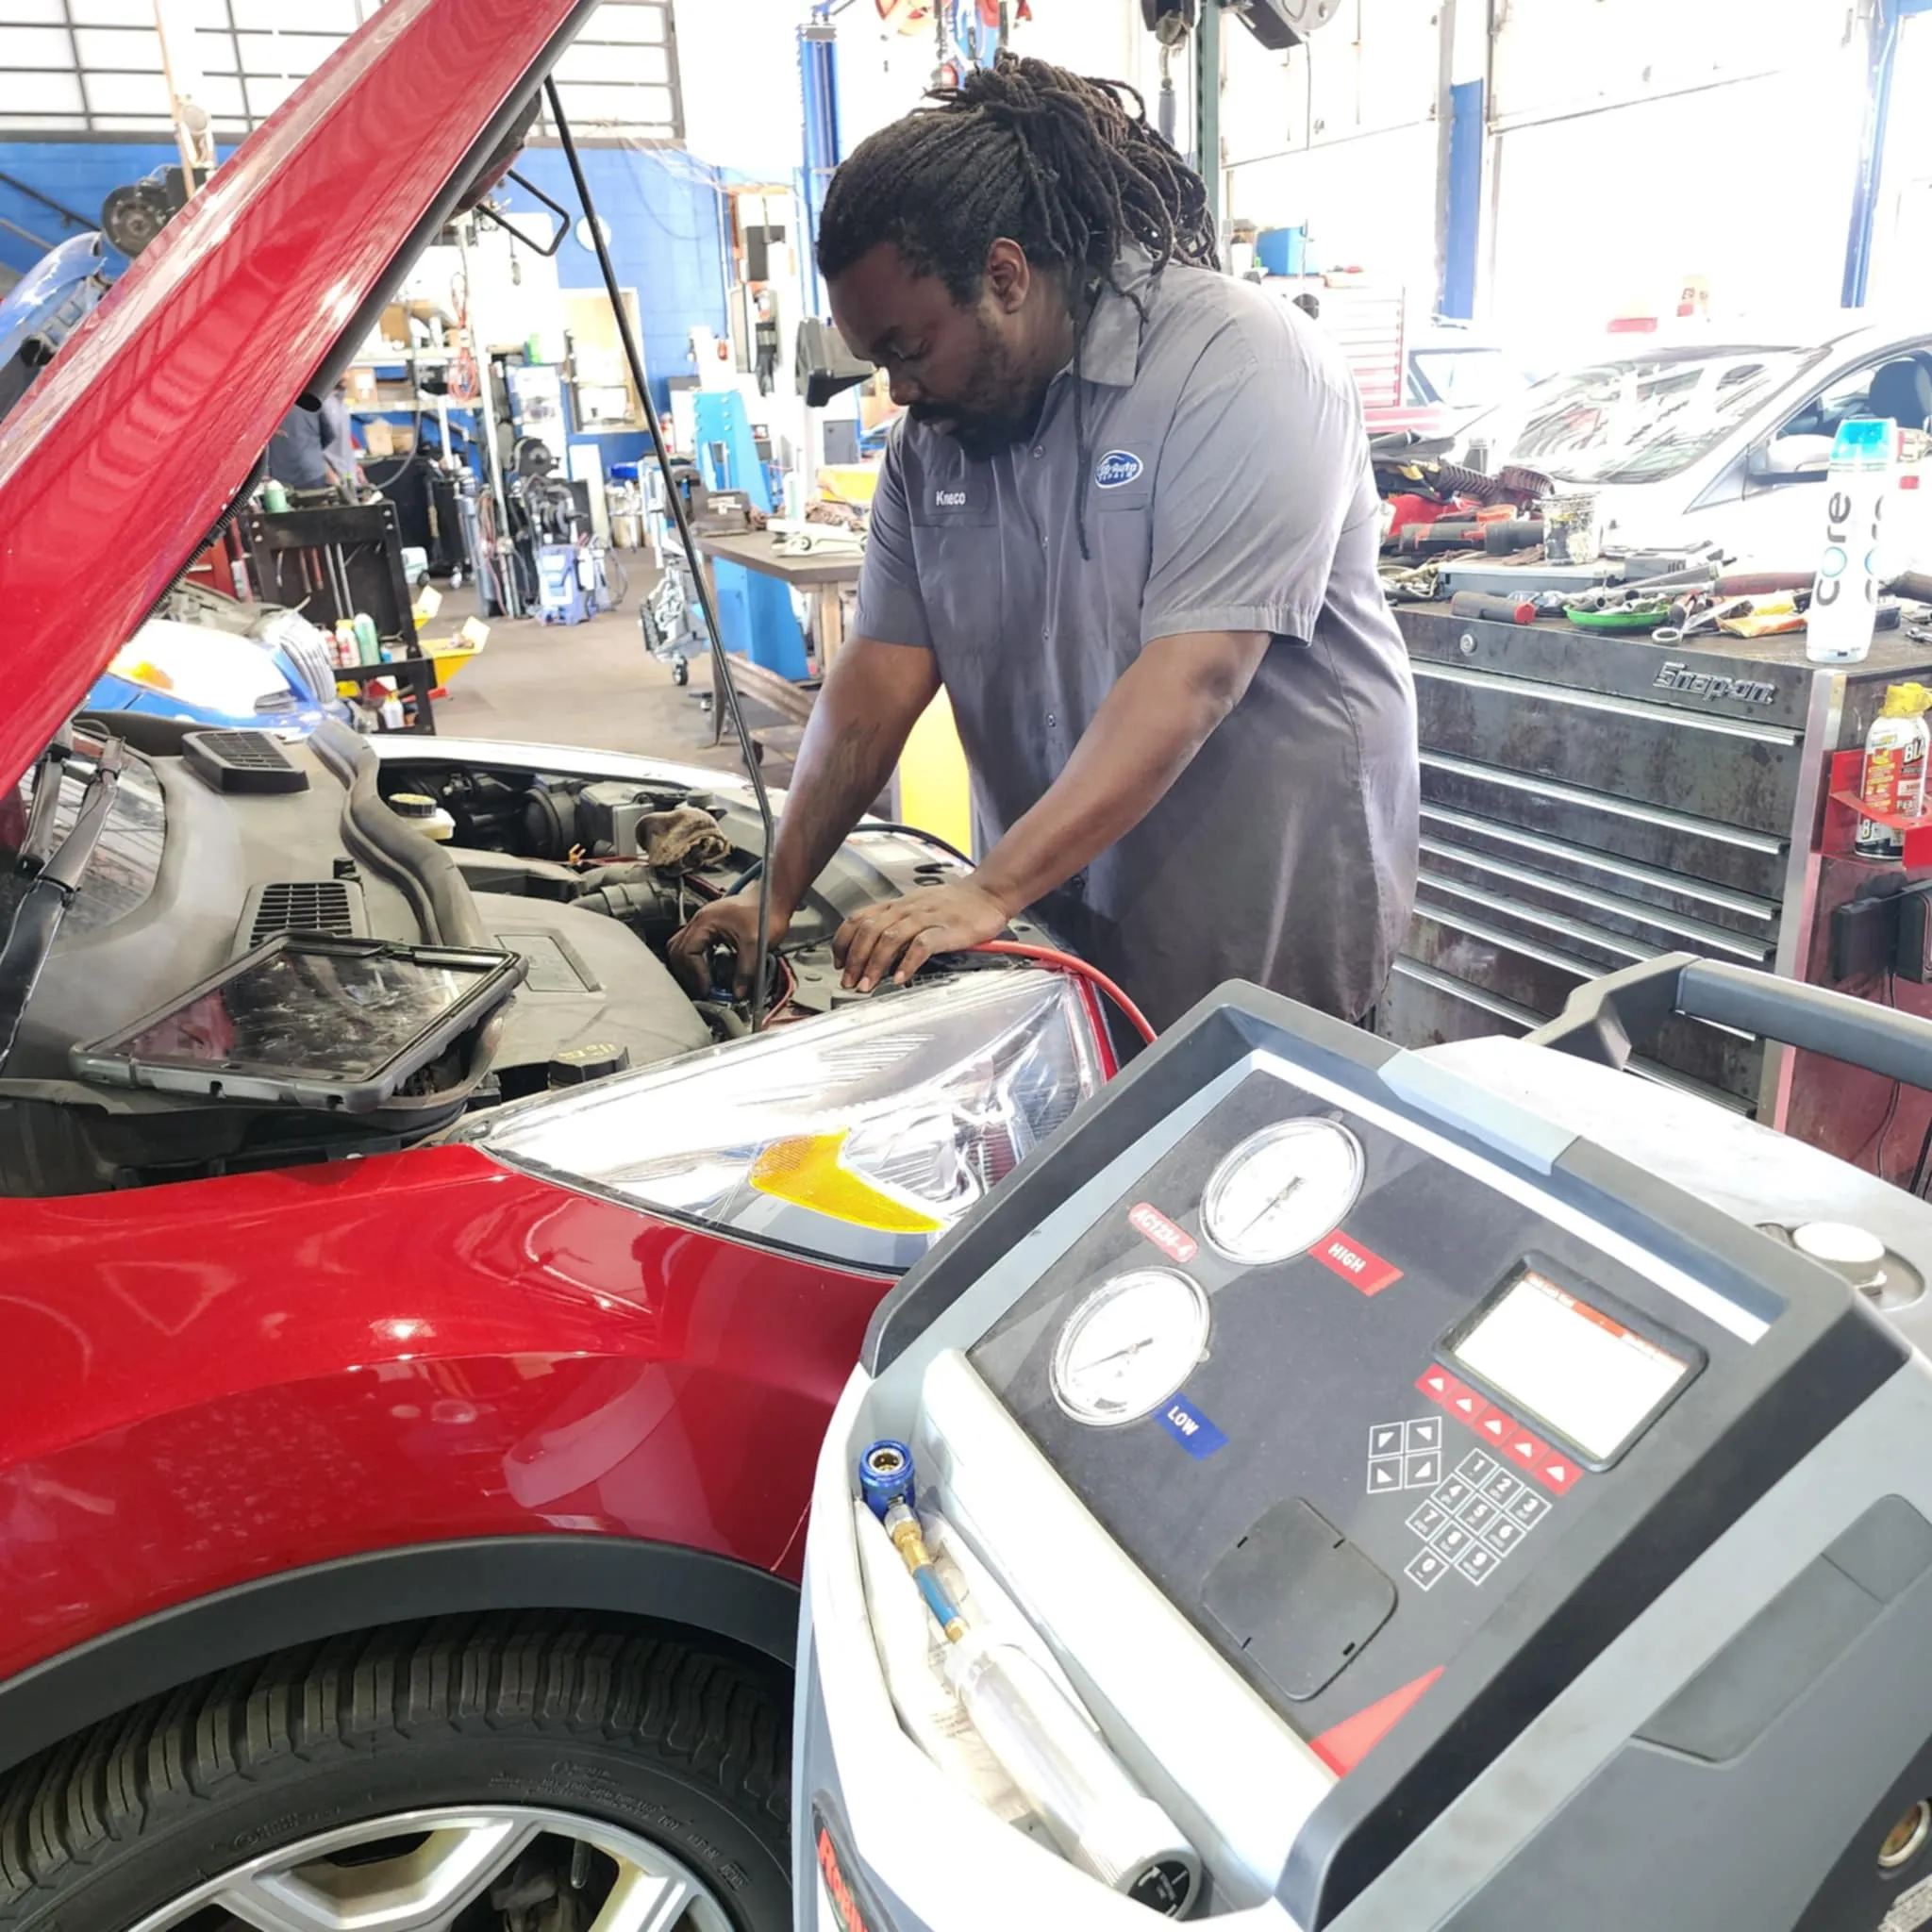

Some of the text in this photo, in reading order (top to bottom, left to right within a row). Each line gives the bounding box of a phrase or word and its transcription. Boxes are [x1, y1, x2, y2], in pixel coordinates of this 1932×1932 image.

[936, 490, 966, 506] Kneco
[1816, 491, 1851, 607] core
[1652, 660, 1774, 705] Snap-on
[1327, 1241, 1367, 1274] HIGH
[1167, 1405, 1200, 1437] LOW
[1474, 1458, 1486, 1473] 1
[1448, 1484, 1463, 1498] 4
[1496, 1477, 1512, 1492] 2
[1473, 1503, 1489, 1518] 5
[1523, 1497, 1539, 1512] 3
[1424, 1509, 1439, 1523] 7
[1447, 1530, 1462, 1545] 8
[1499, 1524, 1514, 1539] 6
[1422, 1557, 1437, 1573] 0
[1472, 1552, 1488, 1567] 9
